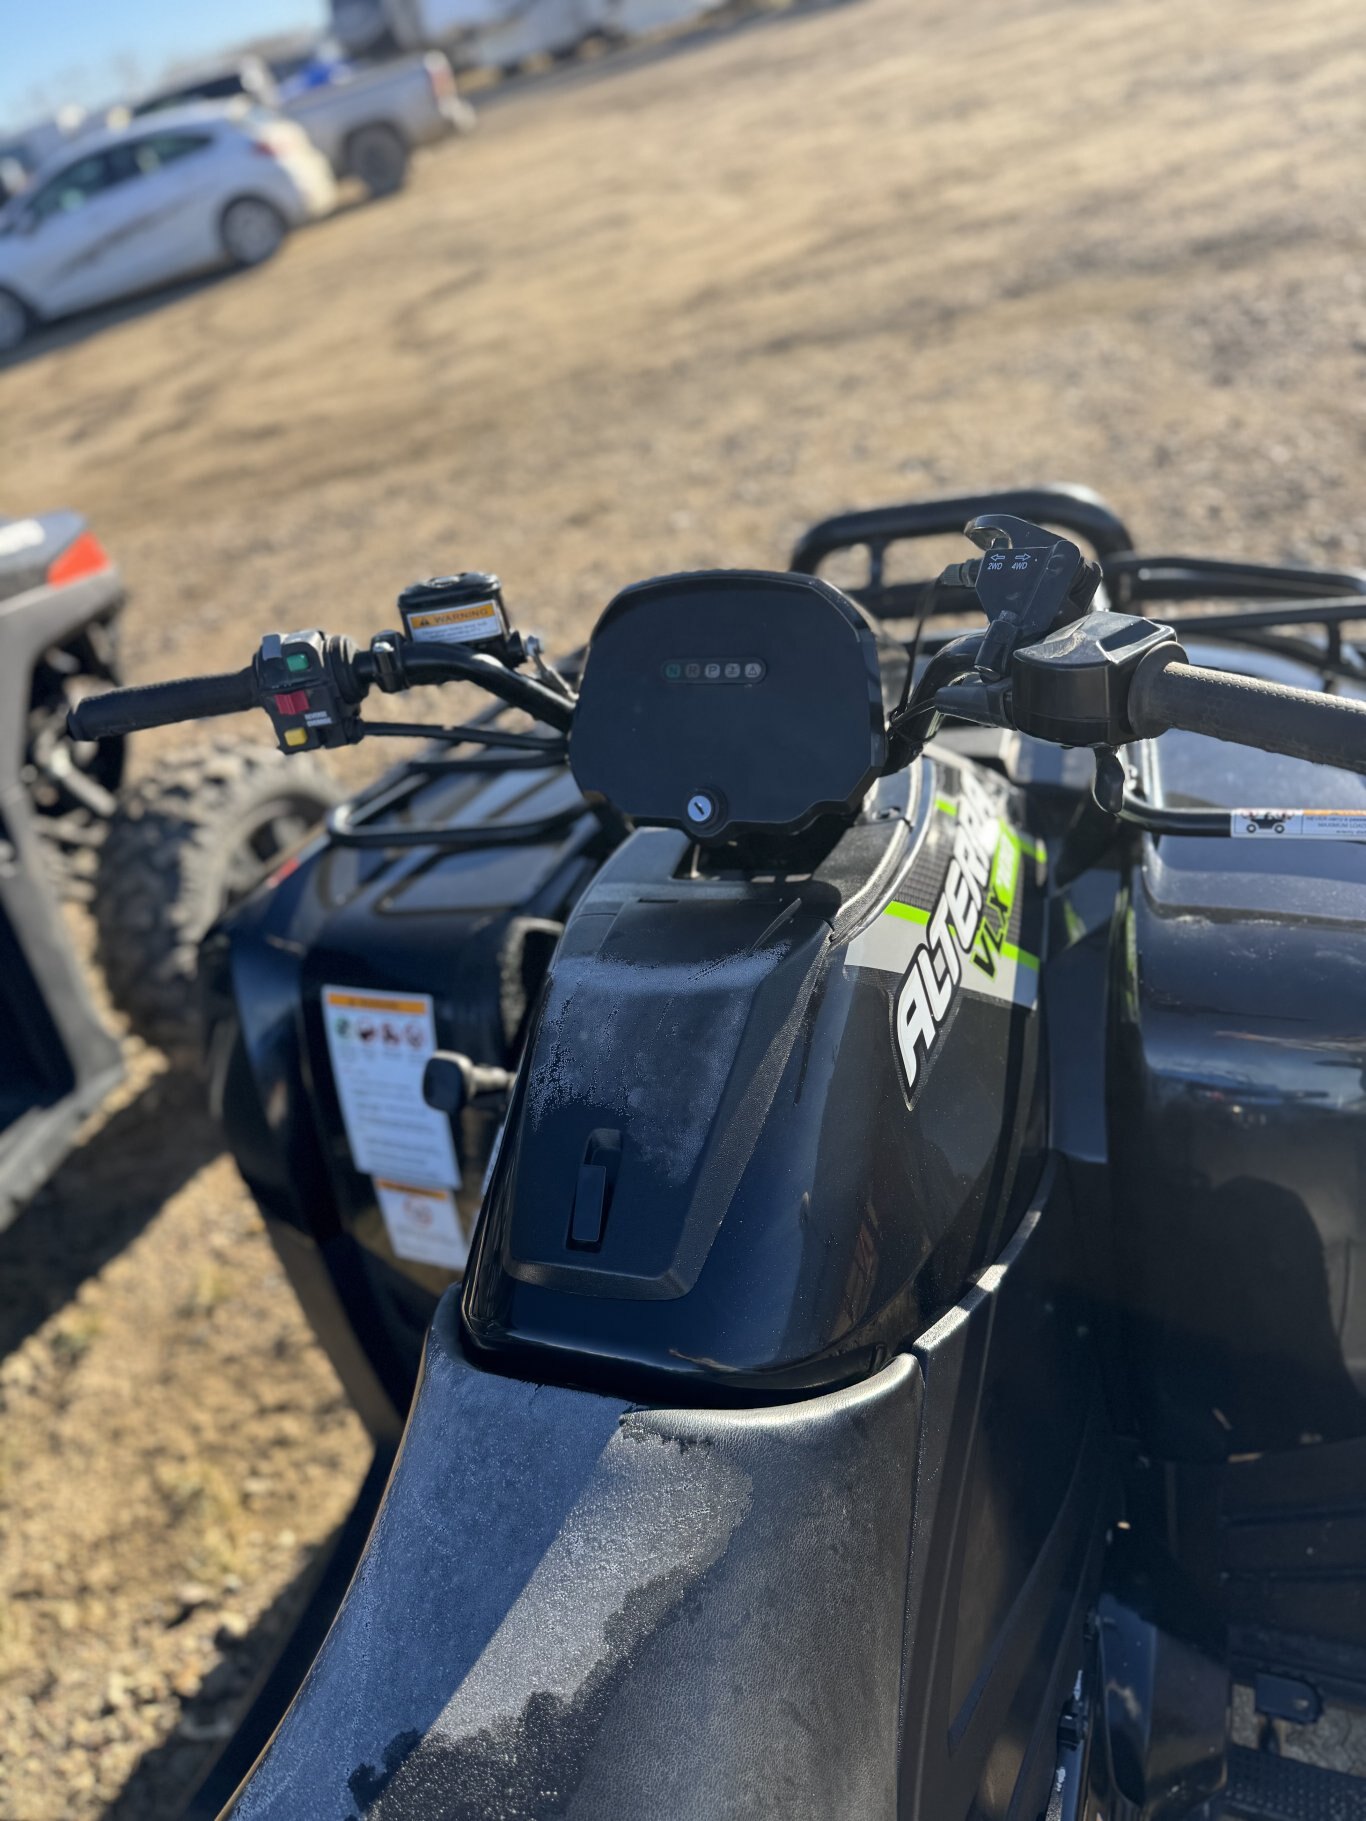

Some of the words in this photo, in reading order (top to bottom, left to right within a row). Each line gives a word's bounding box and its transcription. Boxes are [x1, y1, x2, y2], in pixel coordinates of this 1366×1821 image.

[987, 562, 1003, 570] 2WD
[1011, 561, 1028, 570] 4WD
[435, 607, 489, 624] WARNING
[973, 889, 1010, 979] VLX
